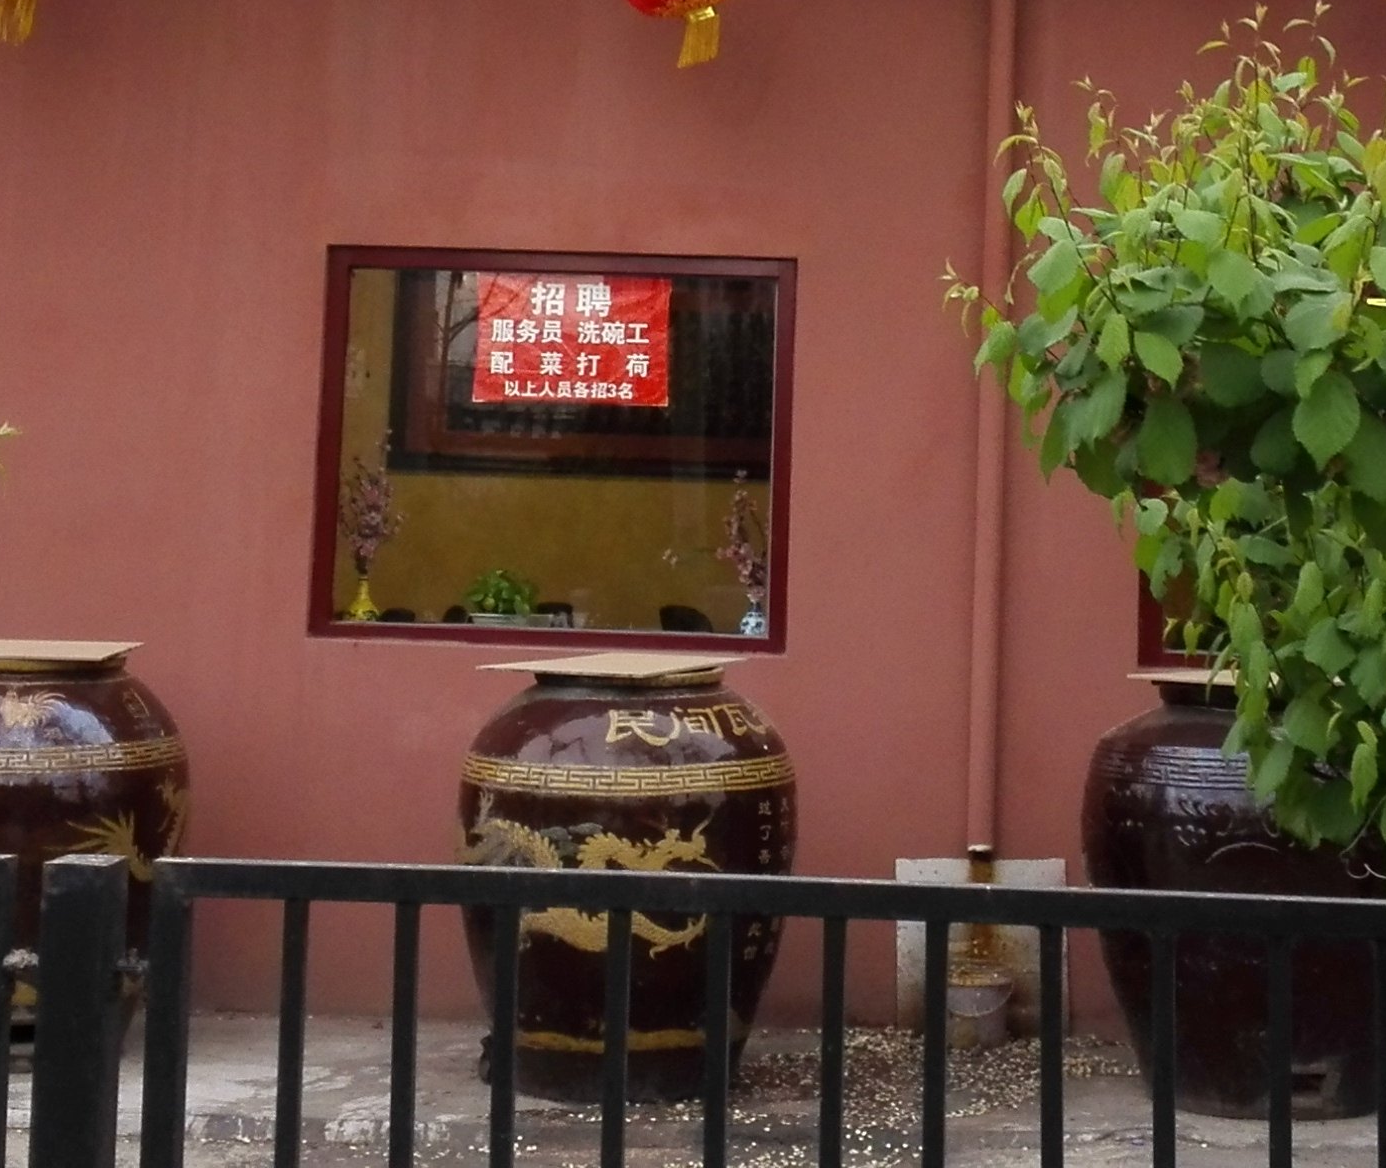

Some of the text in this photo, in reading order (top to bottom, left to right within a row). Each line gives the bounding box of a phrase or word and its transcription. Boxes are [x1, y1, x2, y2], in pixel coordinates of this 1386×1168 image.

[530, 281, 613, 318] 招聘
[490, 318, 651, 345] 服务员 洗碗工
[490, 350, 651, 378] 配菜 打荷
[504, 380, 634, 400] 以上人员各招3名
